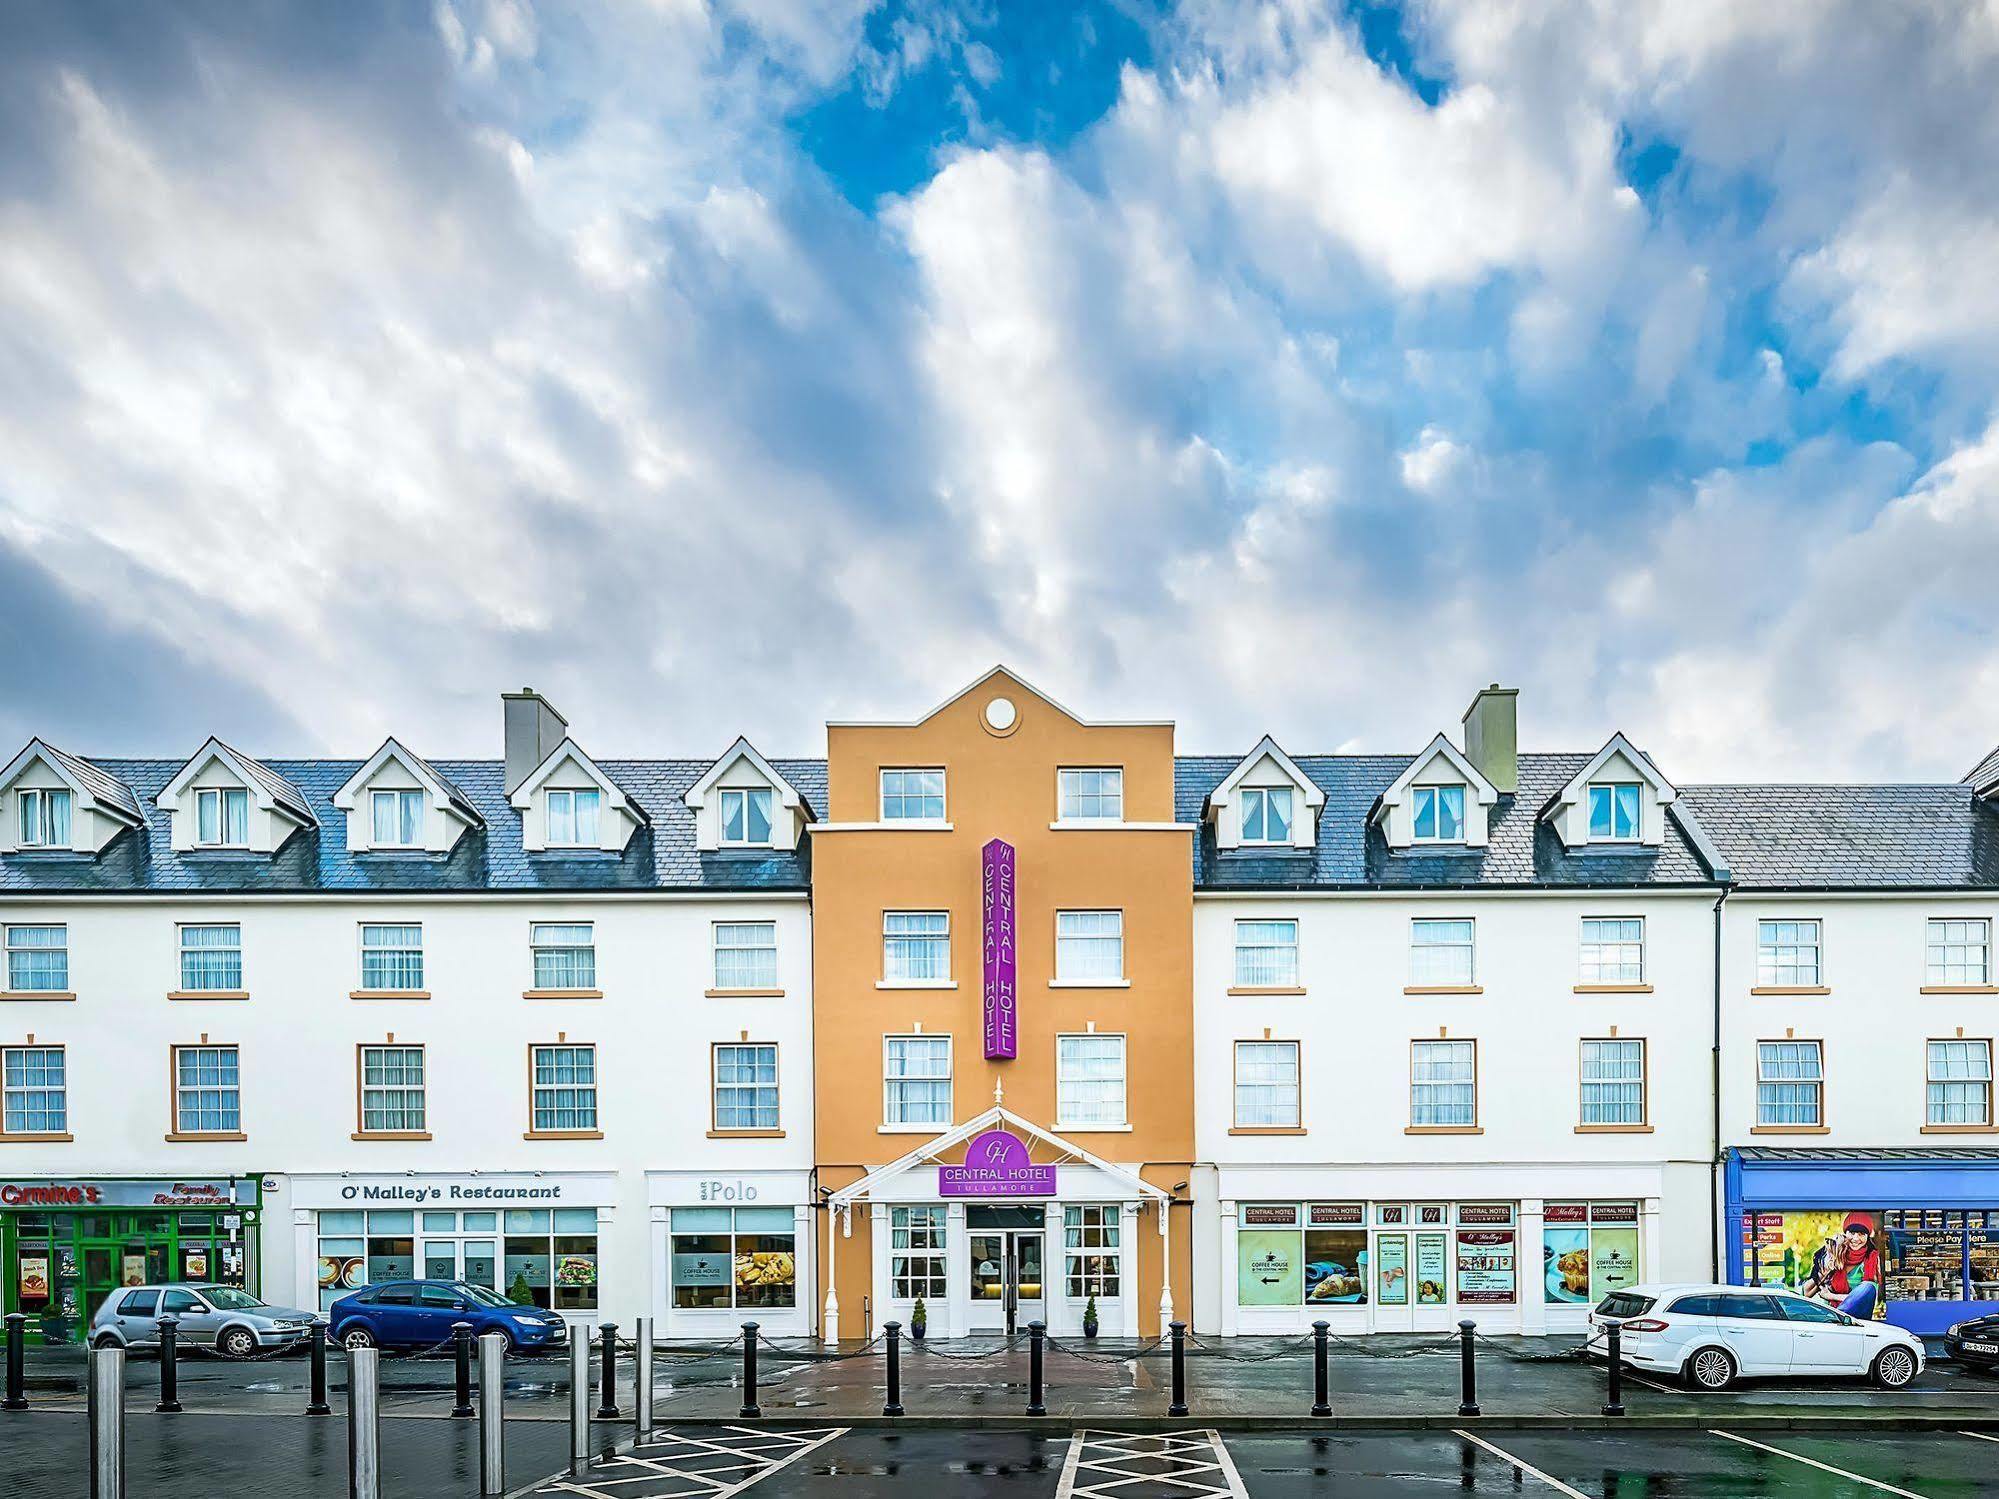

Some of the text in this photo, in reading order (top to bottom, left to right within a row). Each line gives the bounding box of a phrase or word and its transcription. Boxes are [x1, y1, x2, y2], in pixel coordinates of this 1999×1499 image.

[984, 863, 996, 1052] CENTRAL HOTEL
[999, 863, 1013, 1052] CENTRAL HOTEL
[945, 1168, 1050, 1180] CENTRAL HOTEL
[172, 1183, 220, 1196] Family
[450, 1185, 561, 1199] Restaurant
[700, 1180, 758, 1201] BAR Polo
[956, 1184, 1036, 1192] TULLAMORE
[153, 1193, 234, 1205] Restauran
[1917, 1236, 1944, 1244] Please
[1946, 1236, 1962, 1244] Pay
